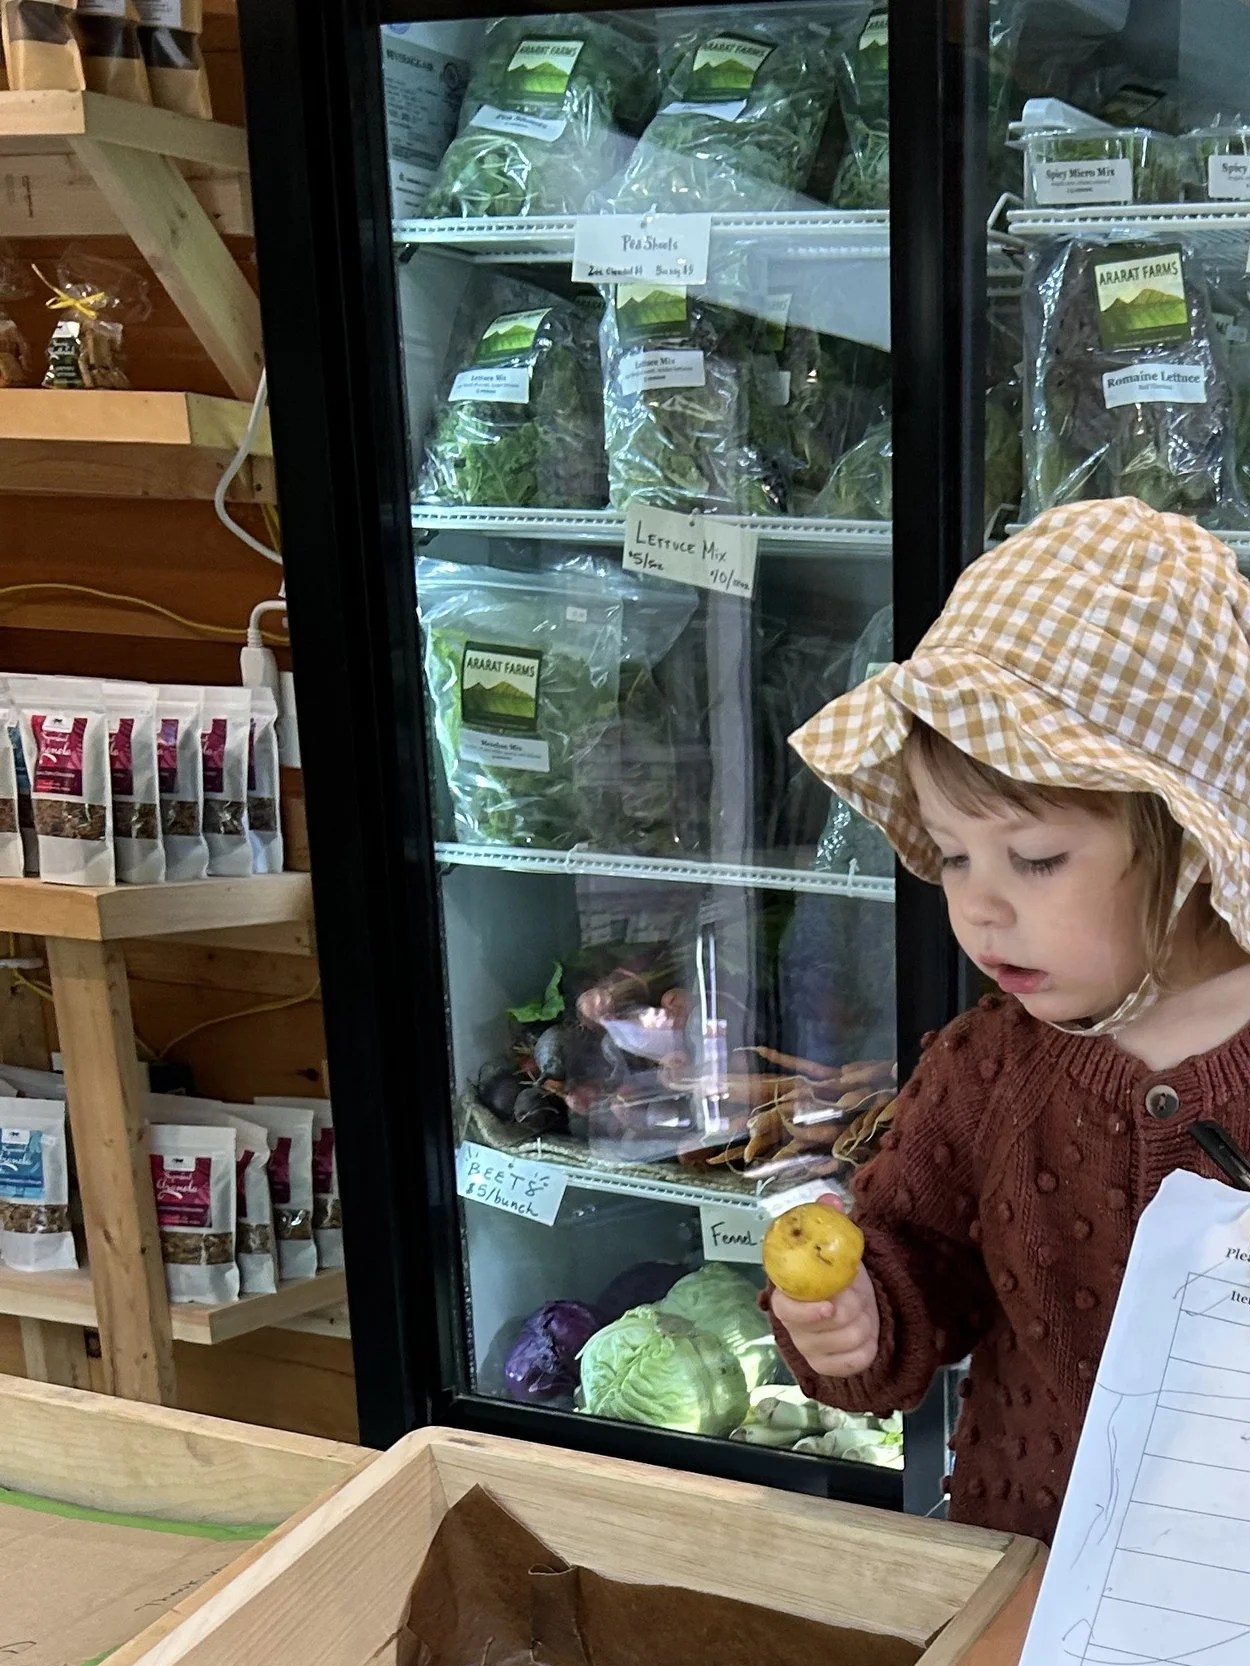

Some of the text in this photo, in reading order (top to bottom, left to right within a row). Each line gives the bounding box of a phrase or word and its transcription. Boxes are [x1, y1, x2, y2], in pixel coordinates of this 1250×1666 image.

[1045, 166, 1115, 181] Spicy Micro Mix
[1221, 162, 1248, 175] Spicy
[1099, 260, 1179, 286] ARARAT FARMS
[1106, 370, 1158, 388] Romaine
[1161, 370, 1201, 384] Lettuce
[466, 657, 535, 678] ARARAT FARMS
[465, 1182, 539, 1217] $5/bunch
